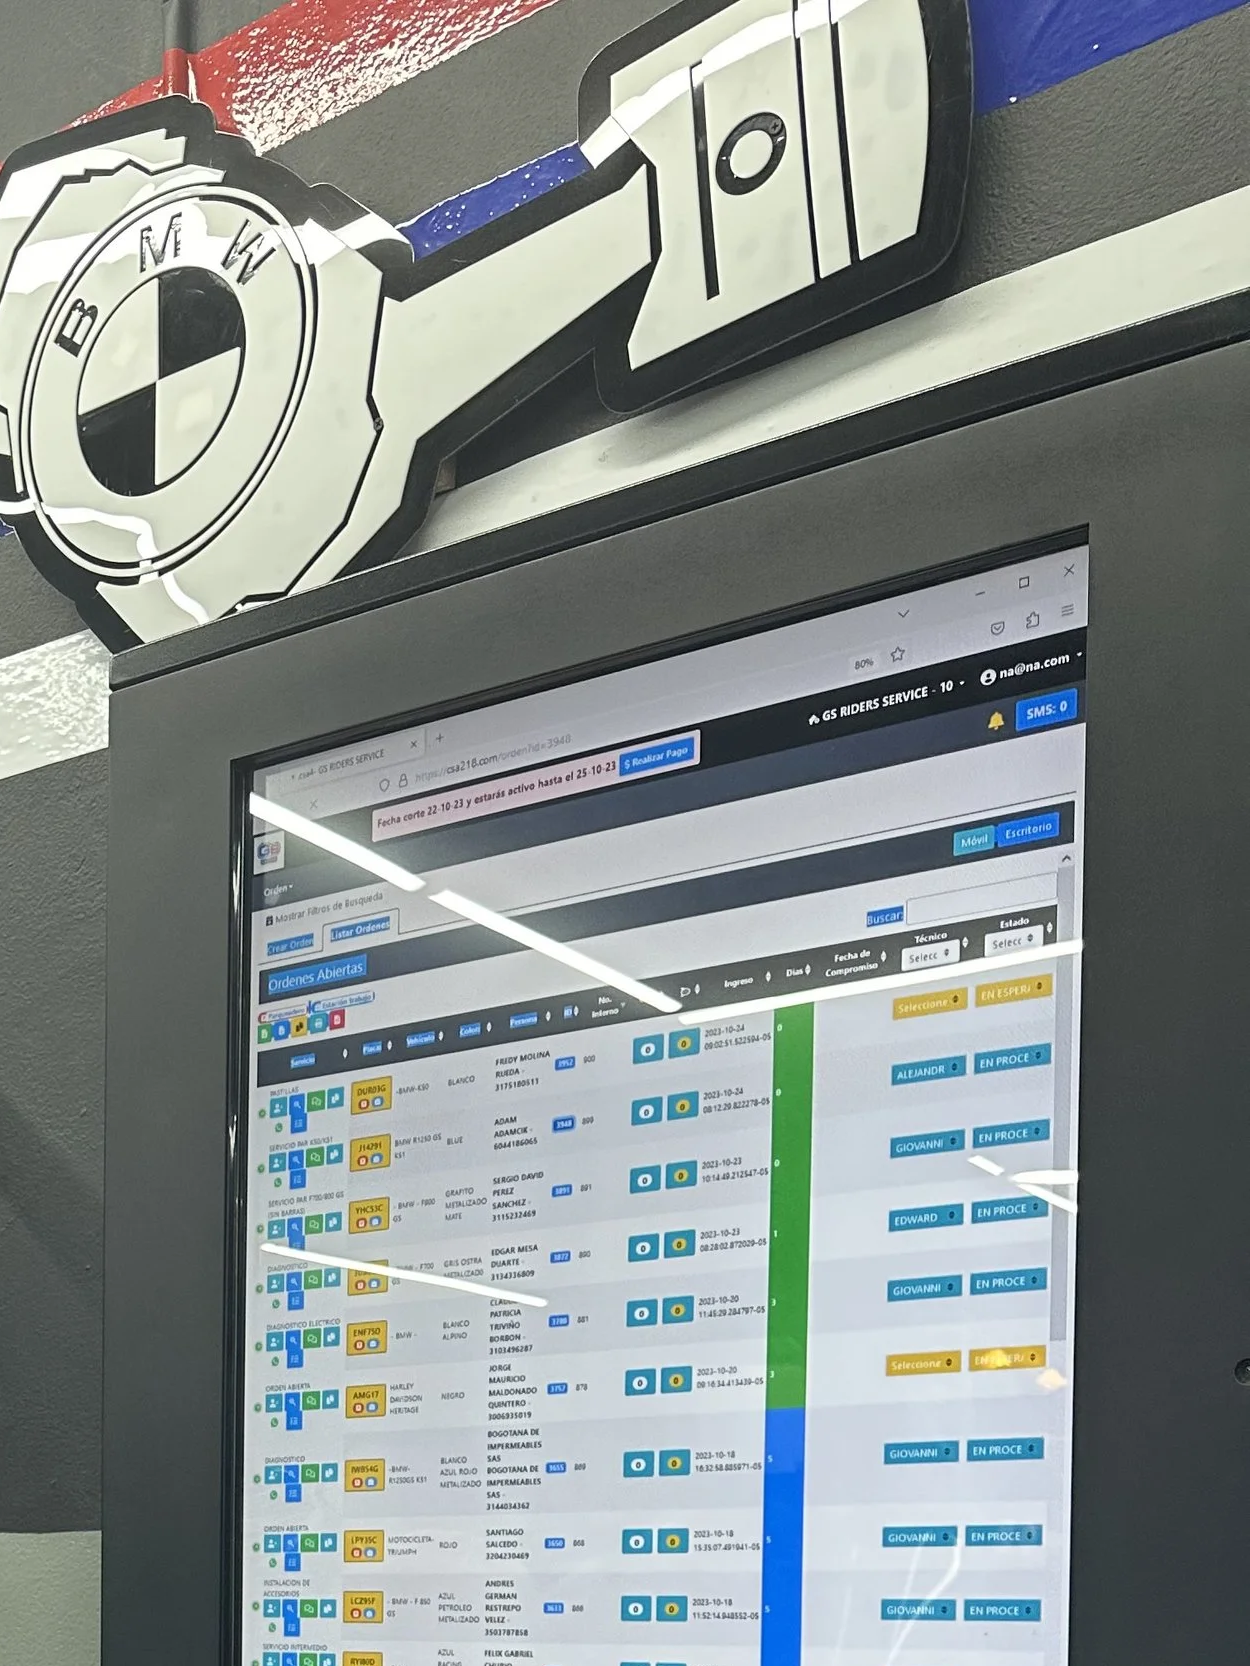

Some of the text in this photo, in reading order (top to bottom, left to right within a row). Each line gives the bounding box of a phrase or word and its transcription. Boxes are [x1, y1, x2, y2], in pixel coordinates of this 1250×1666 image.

[855, 658, 874, 670] 80%
[1000, 653, 1070, 679] na@na.com
[822, 680, 954, 721] GS RIDERS SERVICE 10
[1027, 701, 1067, 720] SMS: 0
[356, 749, 384, 765] SERVICE
[632, 751, 664, 767] Realizar
[666, 747, 688, 759] Pago
[378, 816, 400, 828] Fecha
[403, 809, 425, 822] corte
[466, 799, 471, 808] y
[474, 788, 505, 804] estarás
[508, 781, 535, 796] activo
[538, 776, 562, 788] hasta
[566, 771, 573, 782] el
[1005, 822, 1052, 839] Escritorio
[961, 832, 988, 847] Móvil
[264, 886, 288, 897] Orden
[275, 909, 305, 923] Mostrar
[333, 899, 342, 910] de
[867, 910, 904, 926] Buscar:
[1000, 916, 1029, 929] Estado
[330, 919, 390, 941] Listar Ordenes
[914, 931, 948, 944] Técnico
[992, 936, 1022, 949] Selecc
[834, 949, 870, 963] Fecha de
[910, 950, 937, 963] Selecc
[269, 961, 363, 991] Ordenes Abiertas
[826, 962, 878, 977] Compromiso
[724, 976, 753, 988] Ingreso
[981, 988, 994, 1000] EN
[898, 997, 948, 1014] Seleccione
[592, 1007, 619, 1019] Interno
[980, 1052, 1030, 1068] EN PROCE
[897, 1064, 945, 1080] ALEJANDR
[979, 1128, 1028, 1142] EN PROCE
[896, 1139, 943, 1153] GIOVANNI
[977, 1204, 1026, 1217] EN PROCE
[894, 1213, 938, 1226] EDWARD
[976, 1276, 1025, 1289] EN PROCE
[893, 1284, 941, 1296] GIOVANNI
[891, 1358, 941, 1370] Seleccione
[531, 1428, 539, 1436] DE
[487, 1441, 542, 1450] IMPERMEABLES
[973, 1445, 1022, 1456] EN PROCE
[890, 1449, 938, 1459] GIOVANNI
[487, 1478, 541, 1487] IMPERMEABLES
[888, 1533, 936, 1543] GIOVANNI
[971, 1531, 1021, 1541] EN PROCE
[887, 1605, 935, 1615] GIOVANNI
[970, 1606, 1019, 1616] EN PROCE
